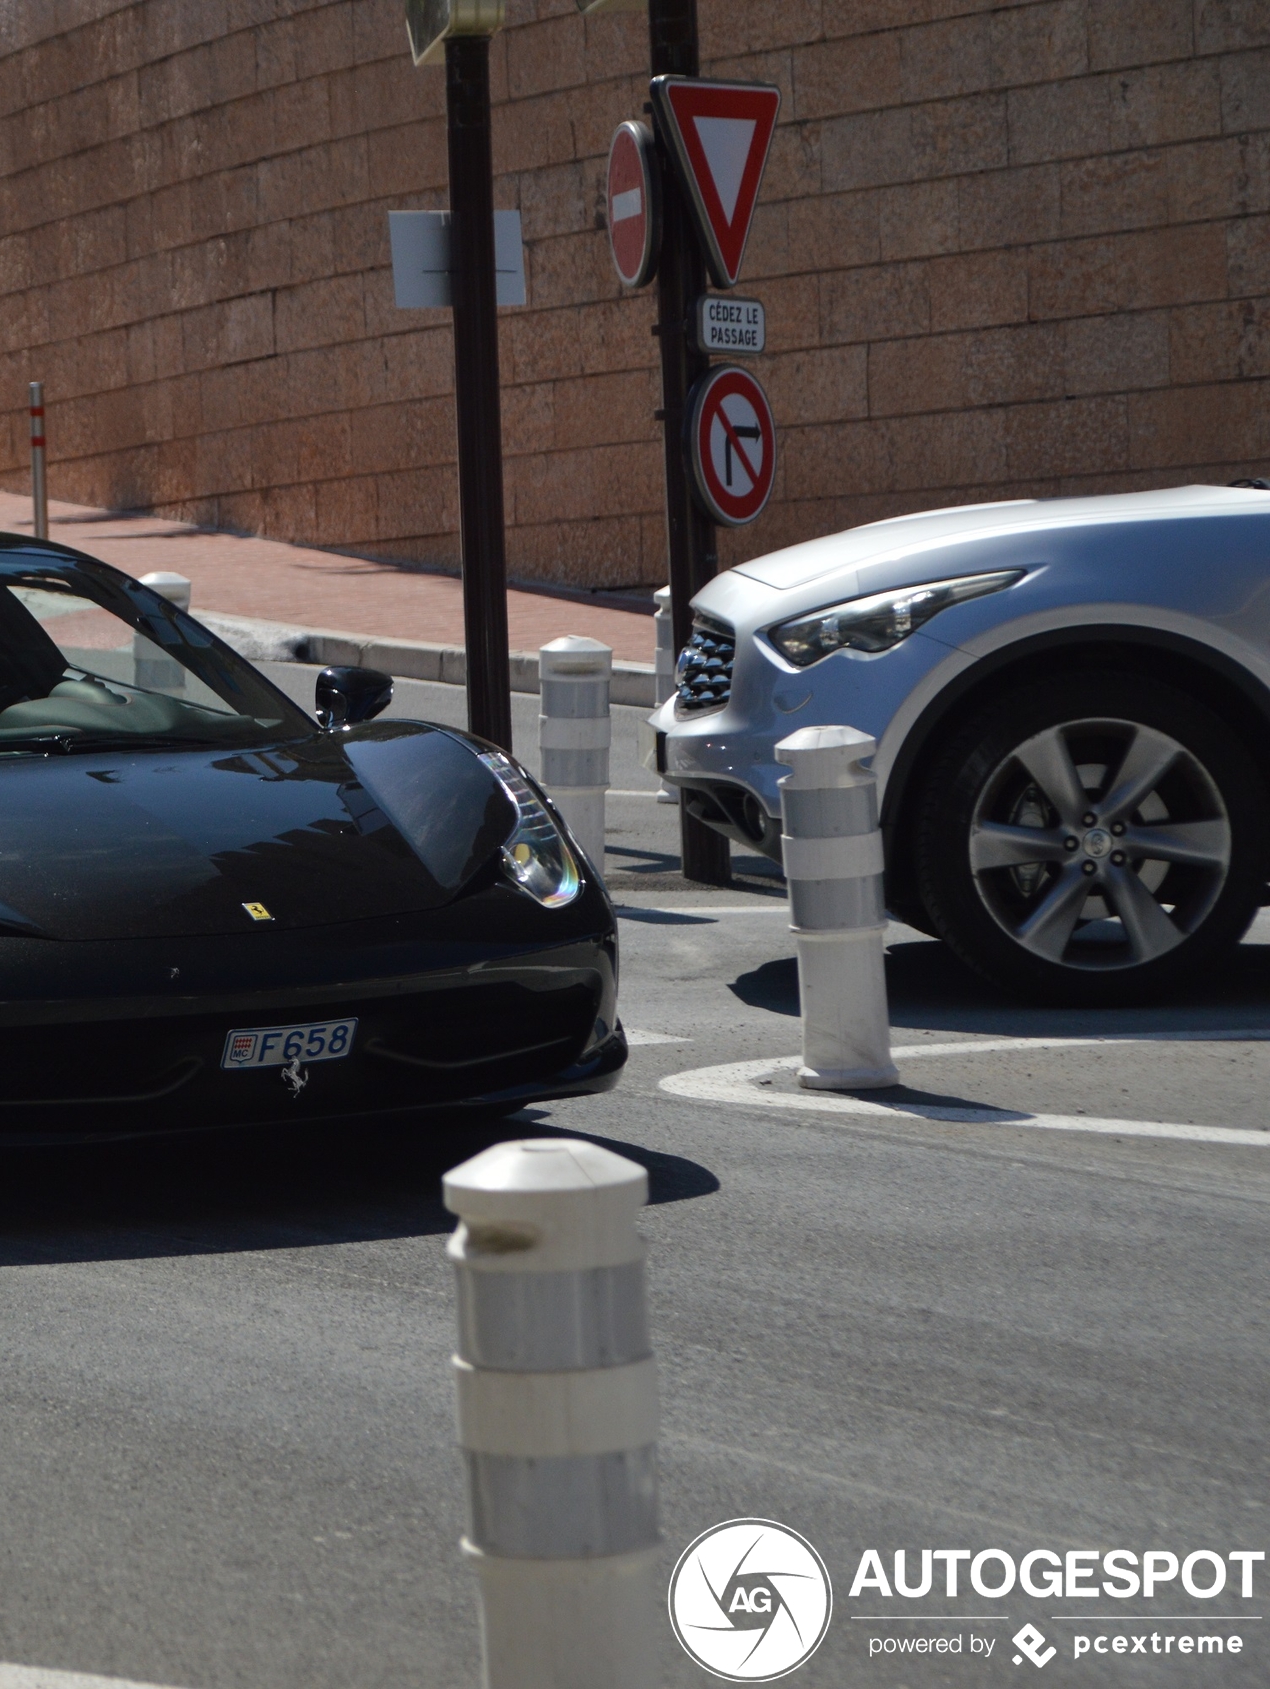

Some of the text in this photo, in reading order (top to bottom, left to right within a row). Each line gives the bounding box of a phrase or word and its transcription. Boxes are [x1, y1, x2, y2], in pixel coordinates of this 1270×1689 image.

[709, 301, 759, 324] CÉDEZ LE
[711, 326, 758, 347] PASSAGE
[233, 1025, 349, 1062] MC F658
